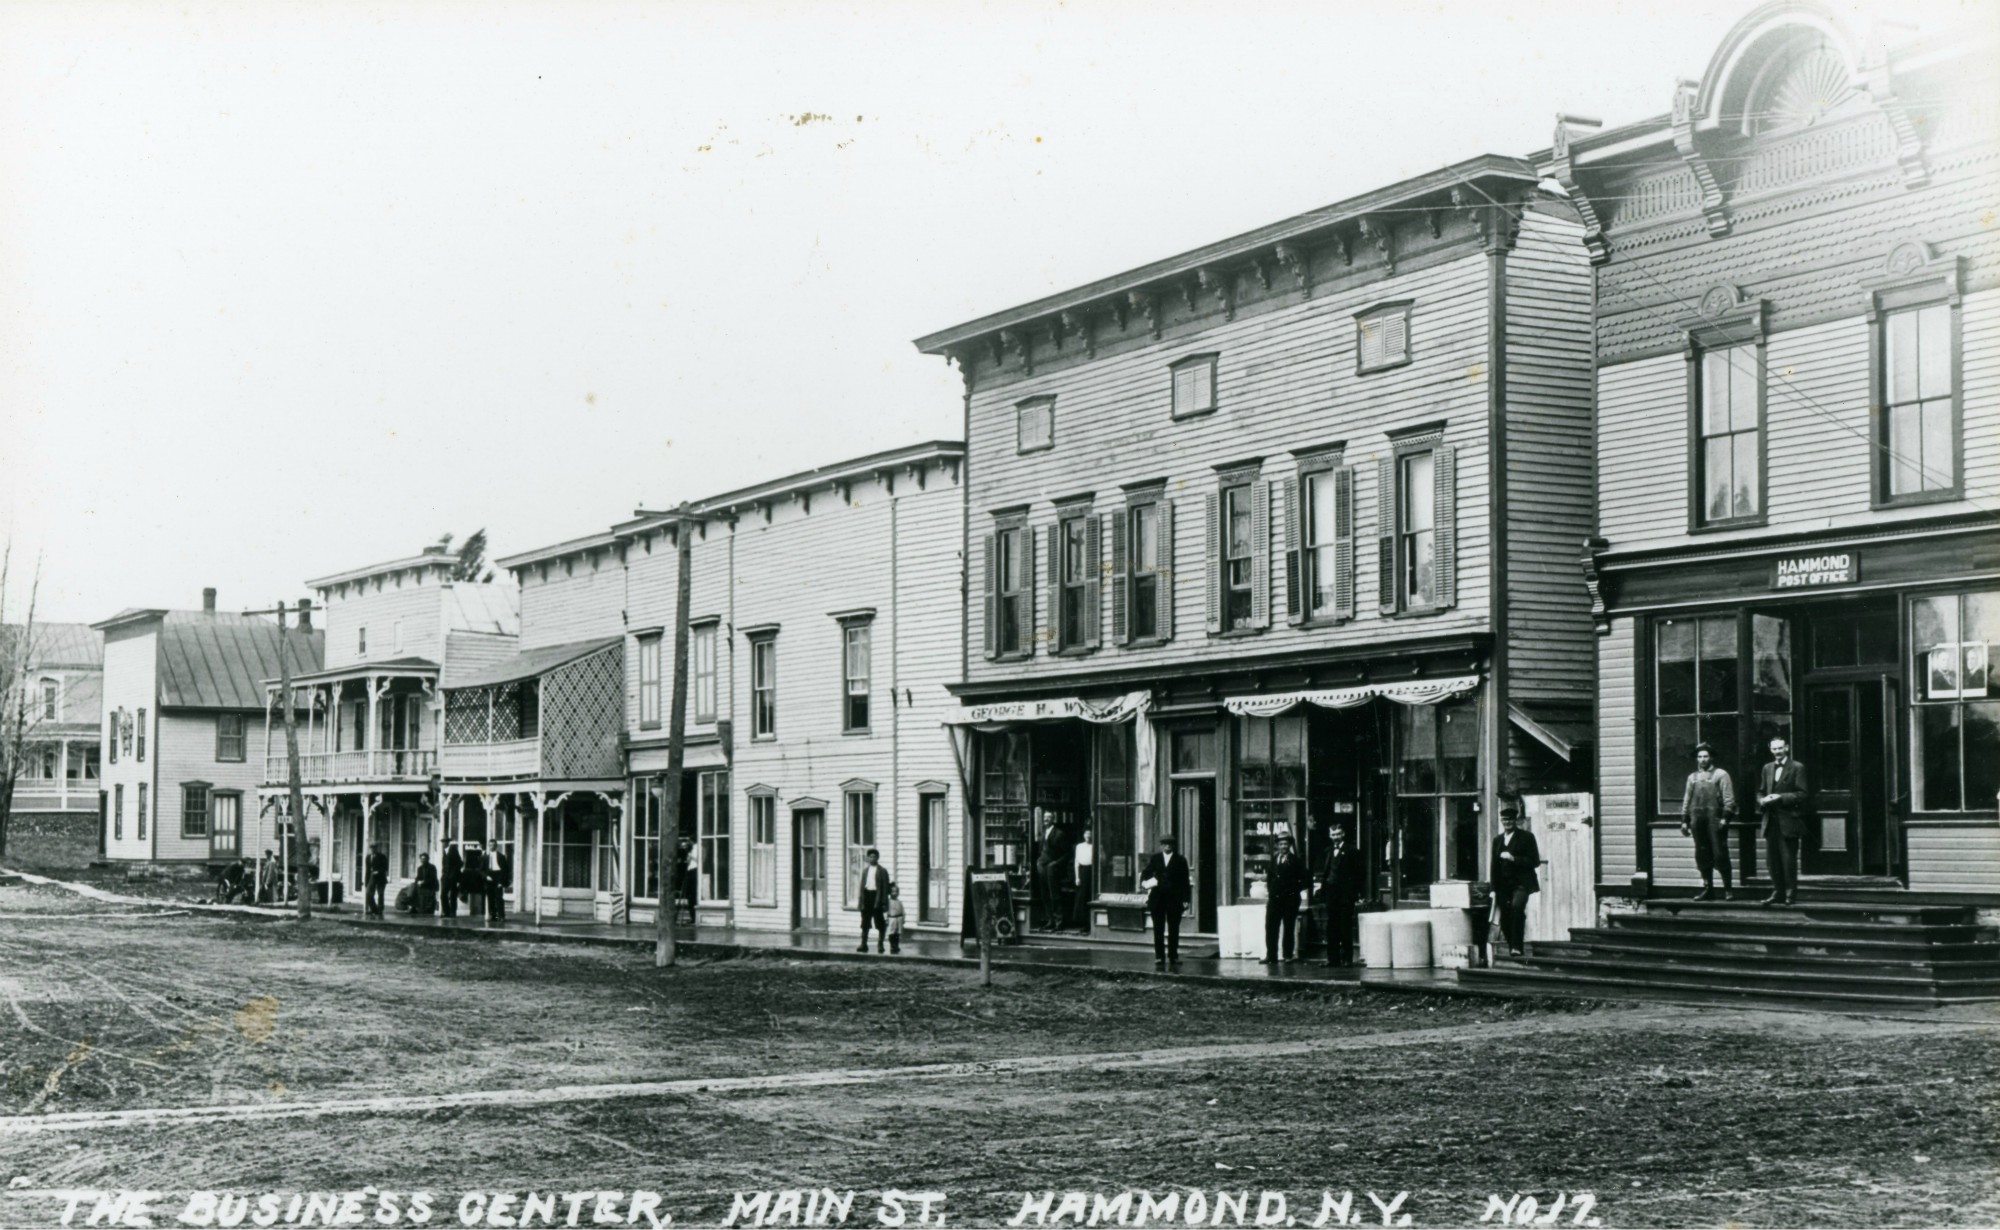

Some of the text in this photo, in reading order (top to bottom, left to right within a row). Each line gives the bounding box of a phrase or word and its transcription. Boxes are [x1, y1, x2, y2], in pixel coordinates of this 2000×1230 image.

[1778, 554, 1850, 575] HAMMOND
[1777, 570, 1849, 588] POST OFFICE
[971, 704, 1026, 720] GEORGE
[1035, 703, 1055, 716] H.
[1256, 821, 1290, 836] SALADA
